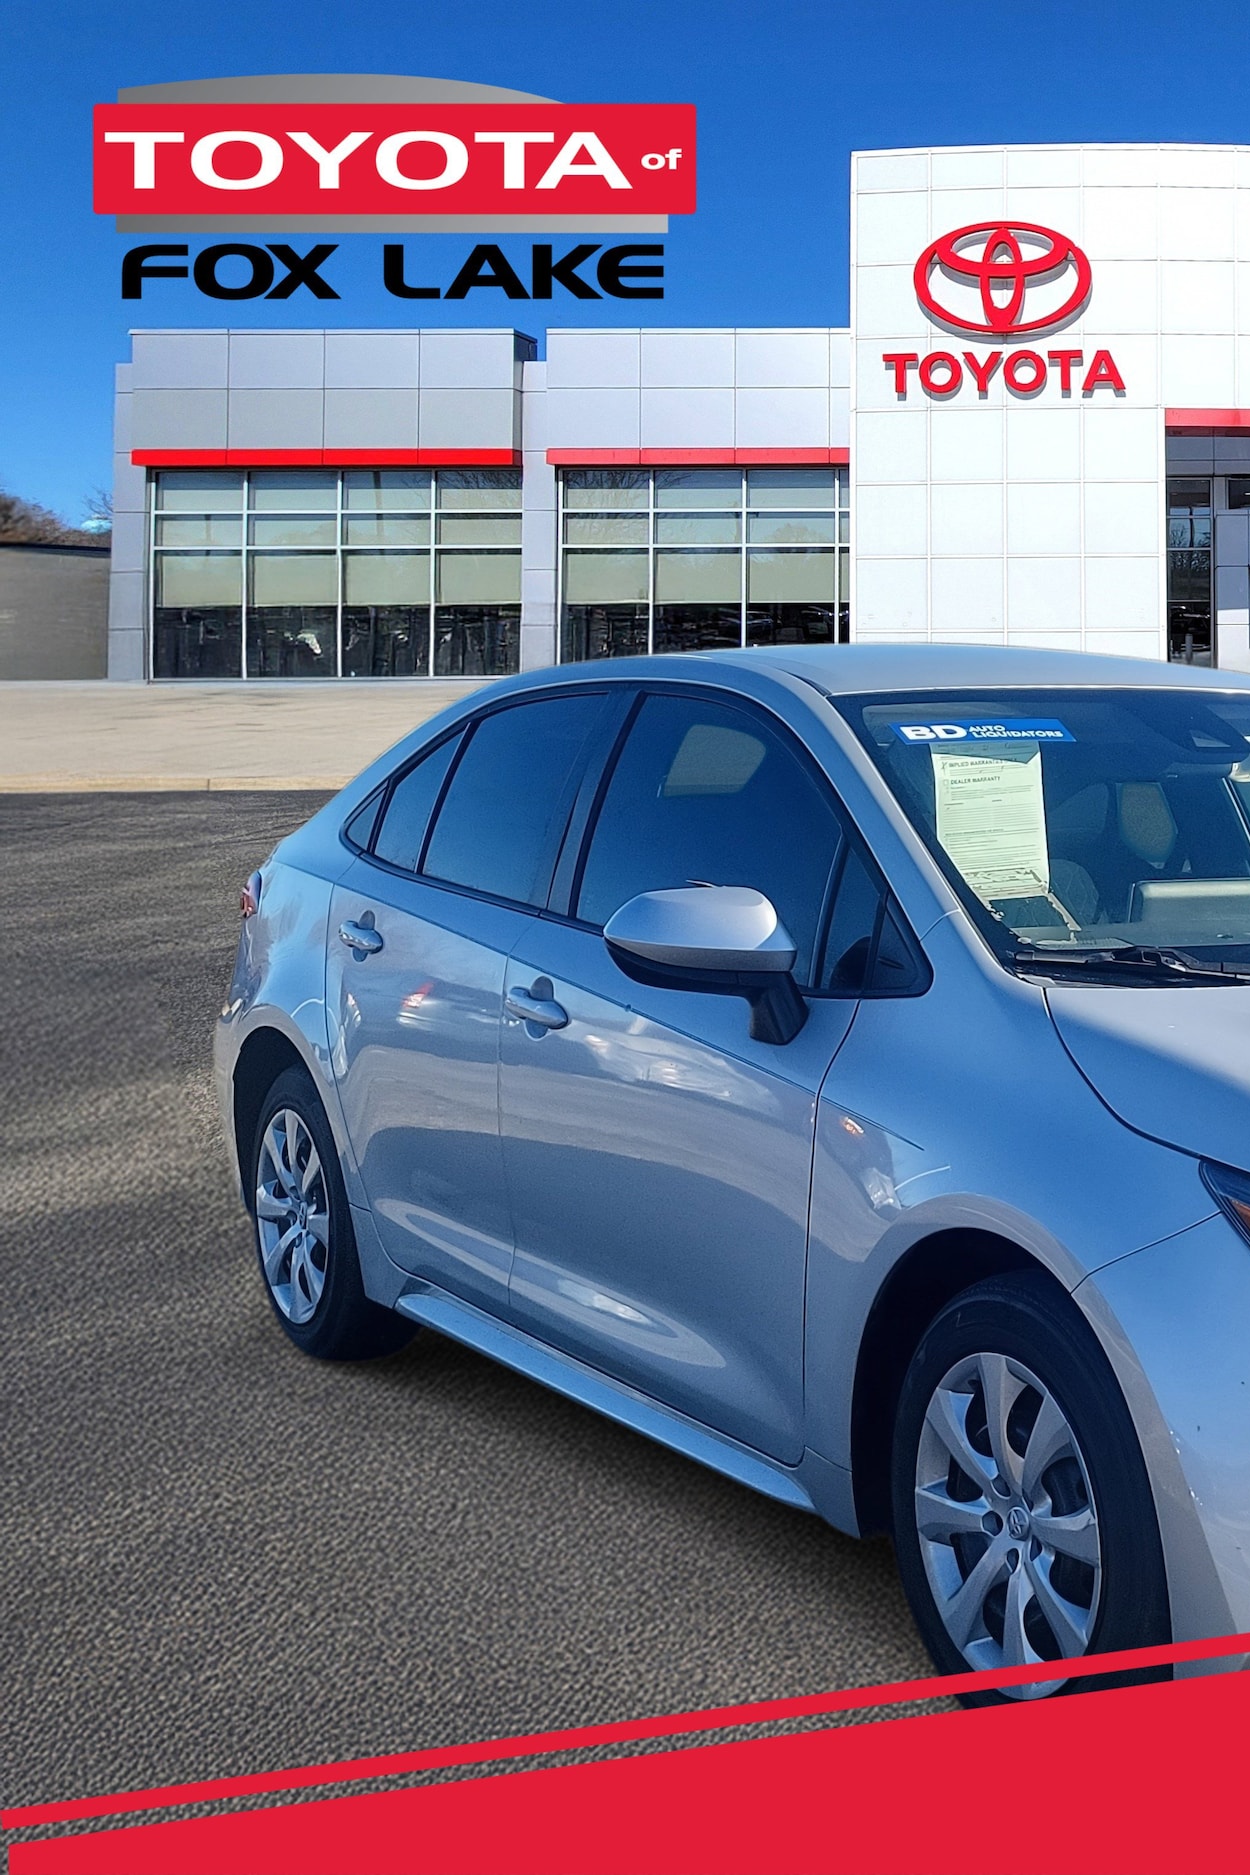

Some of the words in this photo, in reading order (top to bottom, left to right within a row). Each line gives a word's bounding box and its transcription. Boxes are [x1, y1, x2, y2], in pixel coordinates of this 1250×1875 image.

[883, 350, 1126, 397] TOYOTA
[900, 725, 967, 740] BD
[972, 730, 1063, 738] LIQUIDATORS
